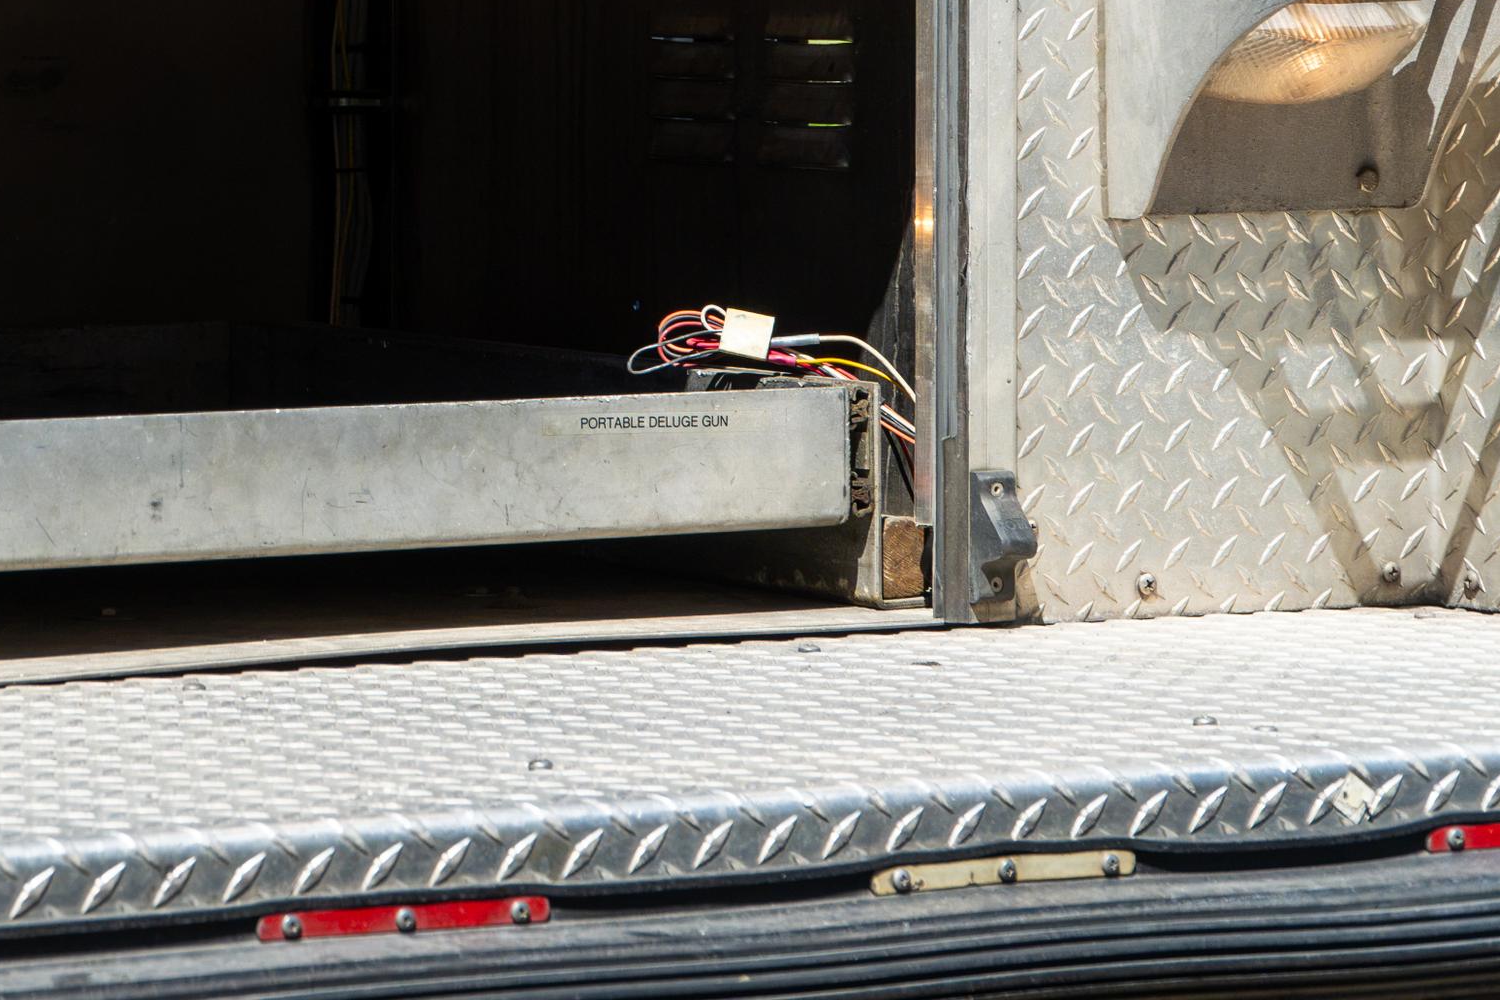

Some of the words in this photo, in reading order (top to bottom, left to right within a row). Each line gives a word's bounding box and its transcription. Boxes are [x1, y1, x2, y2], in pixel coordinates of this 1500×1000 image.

[580, 416, 645, 430] PORTABLE
[649, 416, 698, 428] DELUGE
[702, 415, 729, 428] GUN
